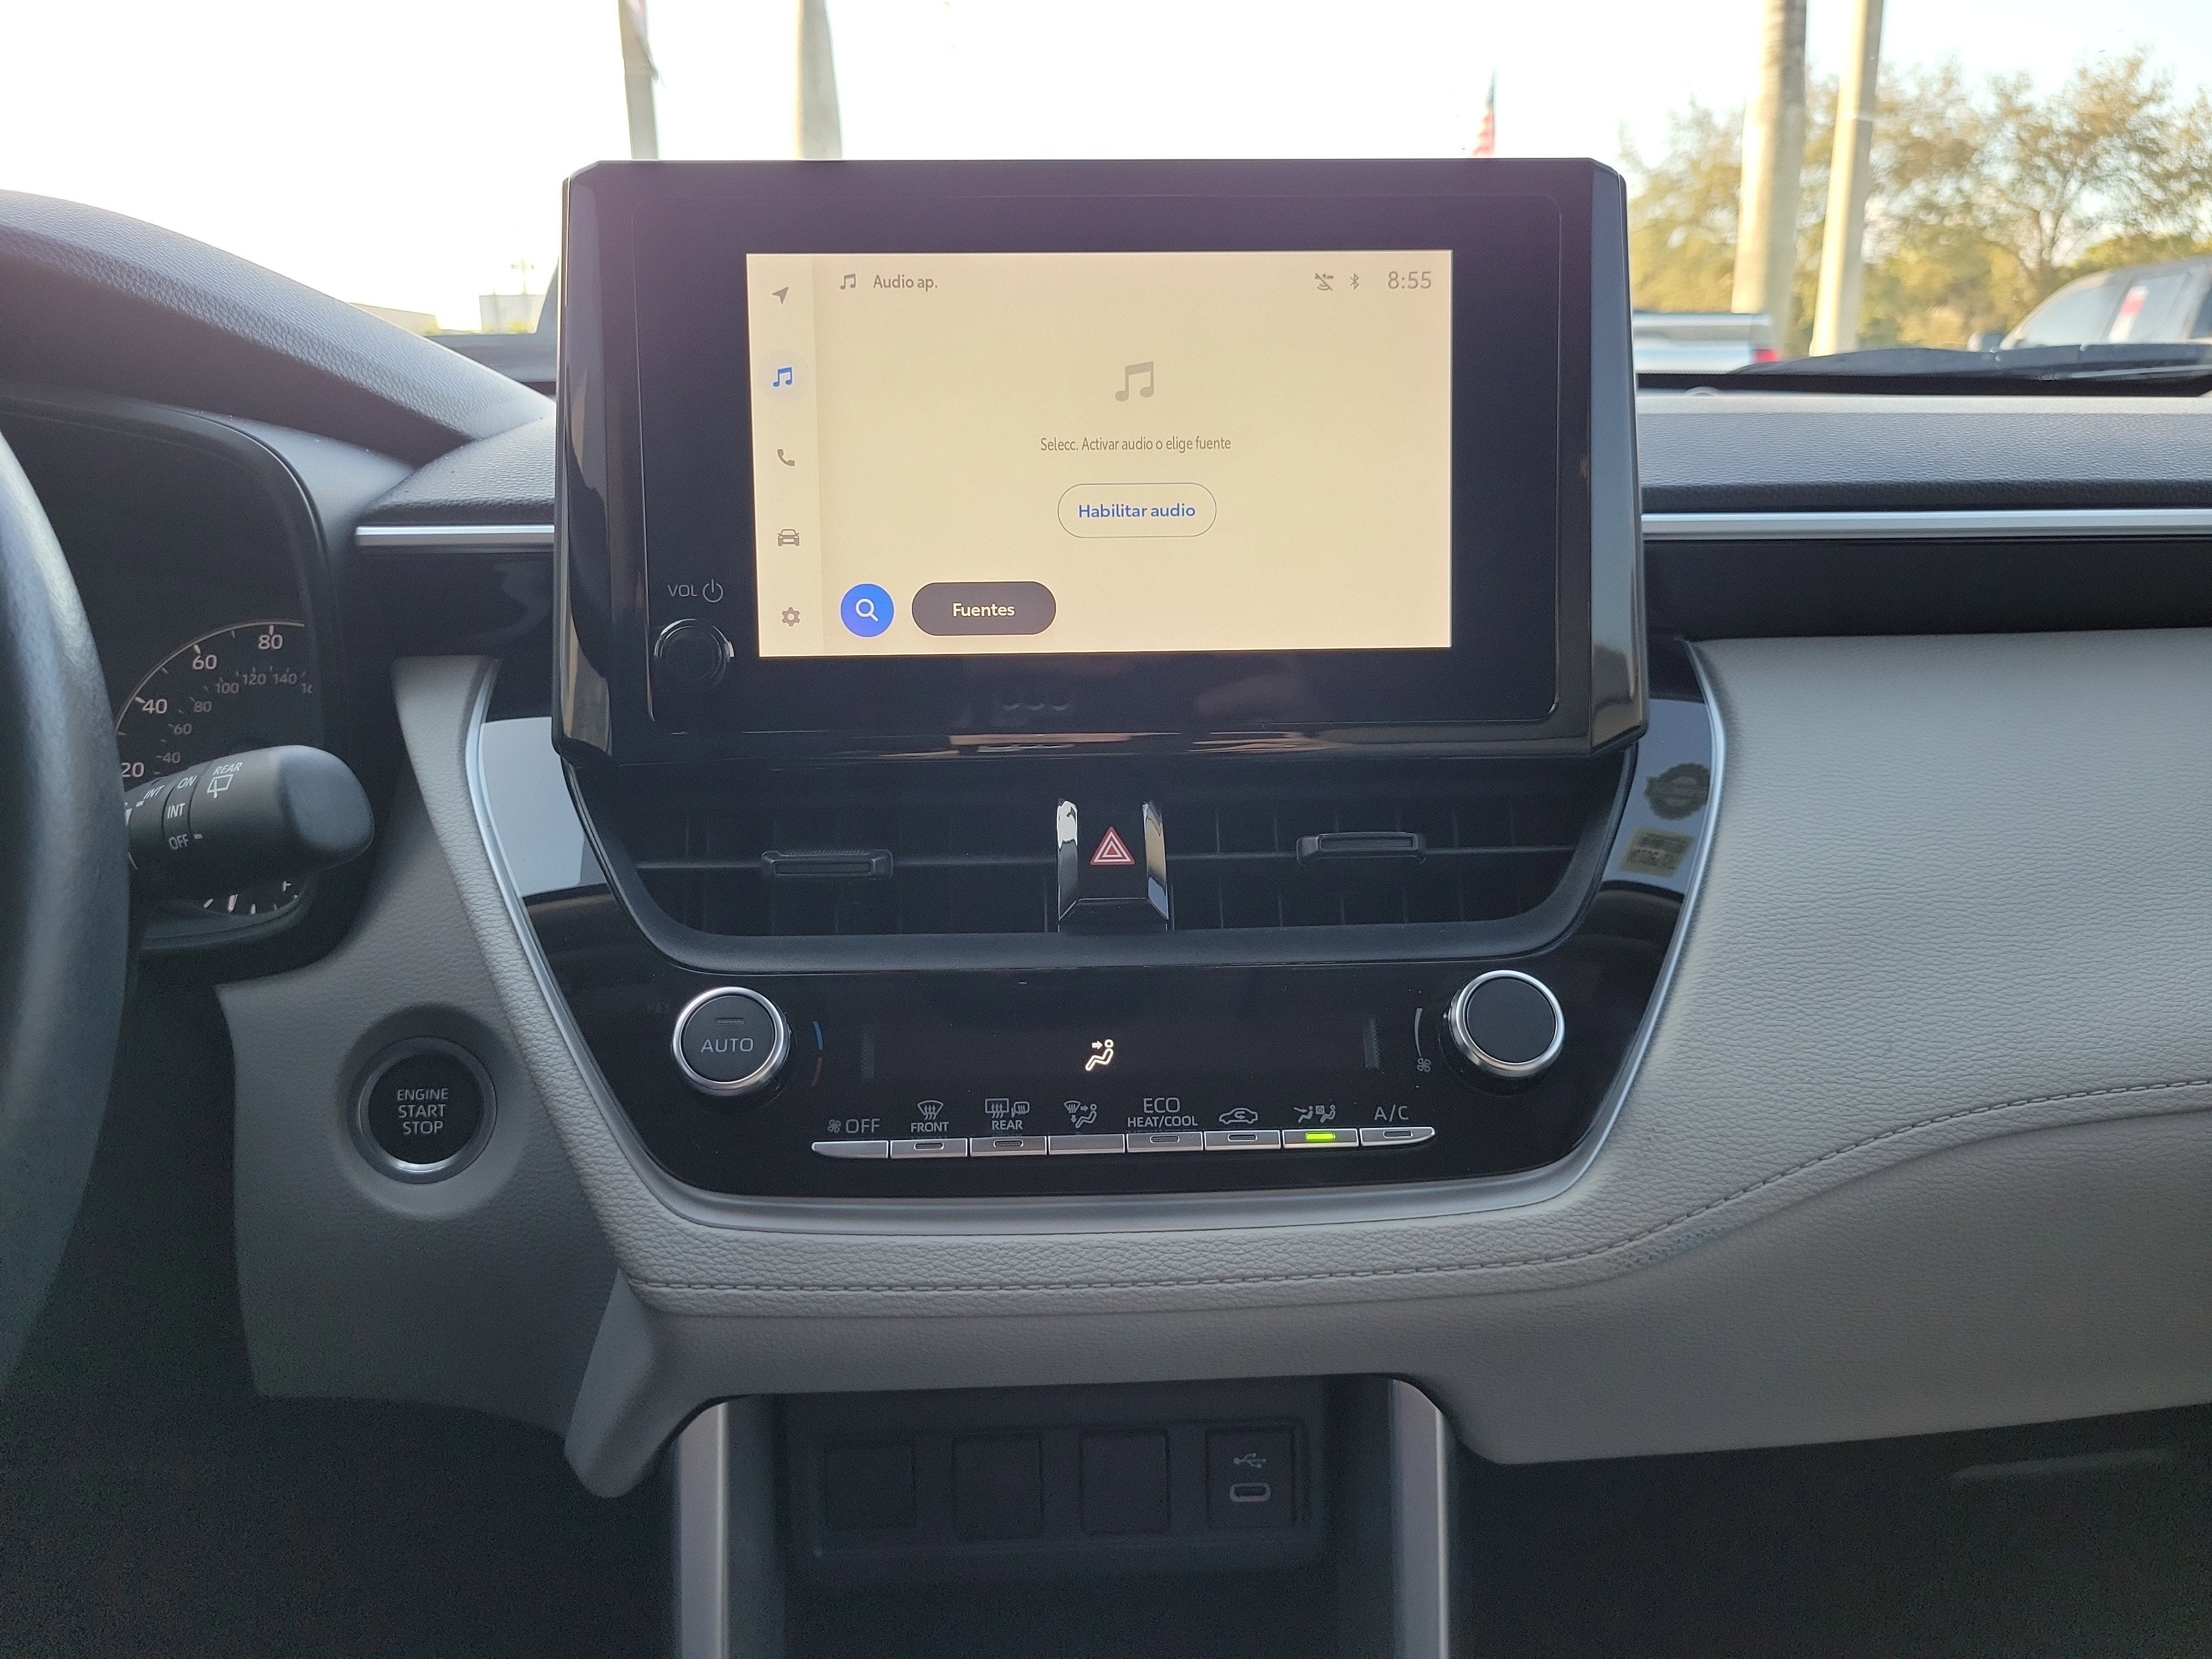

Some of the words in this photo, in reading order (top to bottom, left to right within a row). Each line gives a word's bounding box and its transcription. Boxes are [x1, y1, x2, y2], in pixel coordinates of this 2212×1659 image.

[873, 274, 915, 289] Audio
[917, 278, 938, 292] ap.
[1387, 270, 1432, 290] 8:55
[1040, 437, 1079, 451] Selecc.
[1081, 437, 1120, 450] Activar
[1121, 436, 1153, 450] audio
[1155, 440, 1163, 450] o
[1165, 436, 1193, 454] elige
[1195, 435, 1232, 450] fuente
[1079, 504, 1148, 518] Habilitar
[1150, 503, 1196, 517] audio
[667, 584, 697, 597] VOL
[953, 603, 1015, 617] Fuentes
[258, 634, 283, 650] 80
[192, 654, 217, 670] 60
[242, 673, 267, 685] 120
[273, 673, 297, 684] 140
[215, 682, 240, 694] 100
[141, 698, 167, 714] 40
[194, 701, 212, 713] 80
[173, 723, 192, 735] 60
[162, 752, 181, 764] 40
[120, 762, 144, 780] 20
[212, 761, 243, 776] REAR
[177, 775, 198, 789] ON
[143, 785, 165, 800] INT
[167, 802, 185, 819] INT
[168, 833, 189, 850] OFF
[701, 1037, 754, 1053] AUTO
[397, 1088, 448, 1101] ENGINE
[398, 1104, 446, 1119] START
[1143, 1097, 1181, 1114] ECO
[1374, 1104, 1409, 1122] A/C
[402, 1120, 443, 1135] STOP
[845, 1118, 880, 1133] OFF
[911, 1121, 949, 1133] FRONT
[991, 1119, 1023, 1131] REAR
[1127, 1115, 1198, 1128] HEAT/COOL
